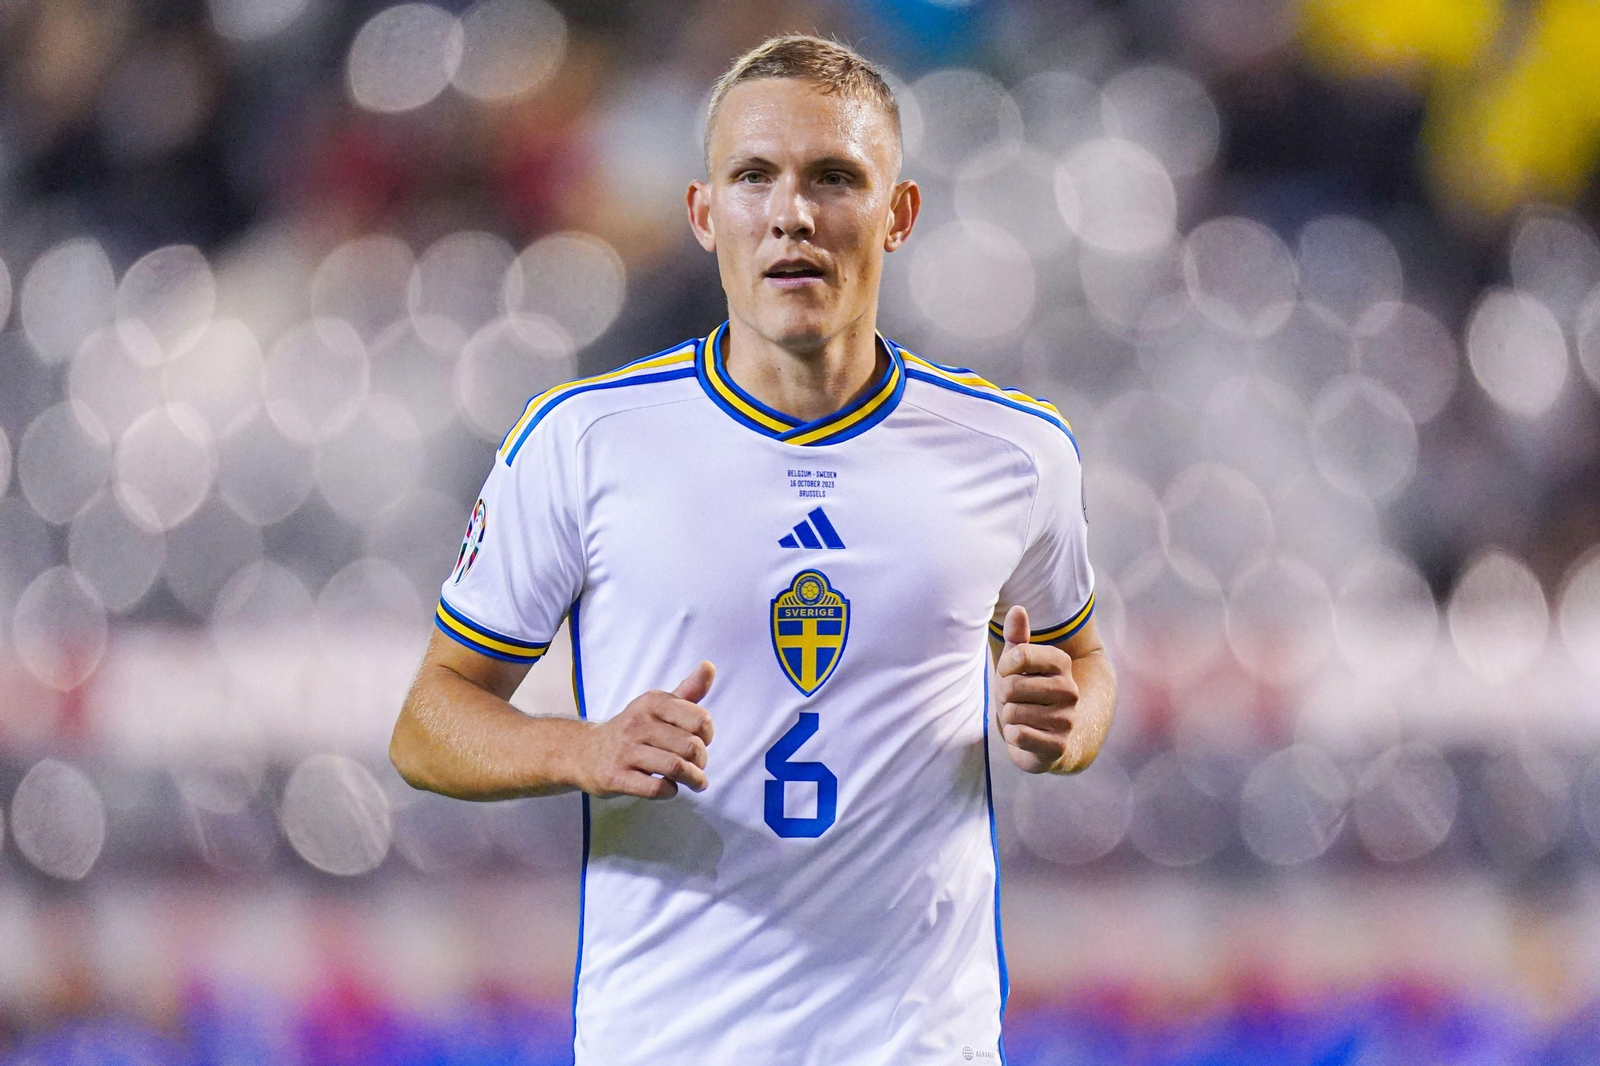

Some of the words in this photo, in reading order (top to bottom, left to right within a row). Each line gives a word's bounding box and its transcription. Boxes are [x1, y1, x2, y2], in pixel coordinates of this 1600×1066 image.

[799, 490, 826, 498] BRUSSELS
[785, 608, 835, 617] SVERIGE
[764, 712, 838, 838] 6
